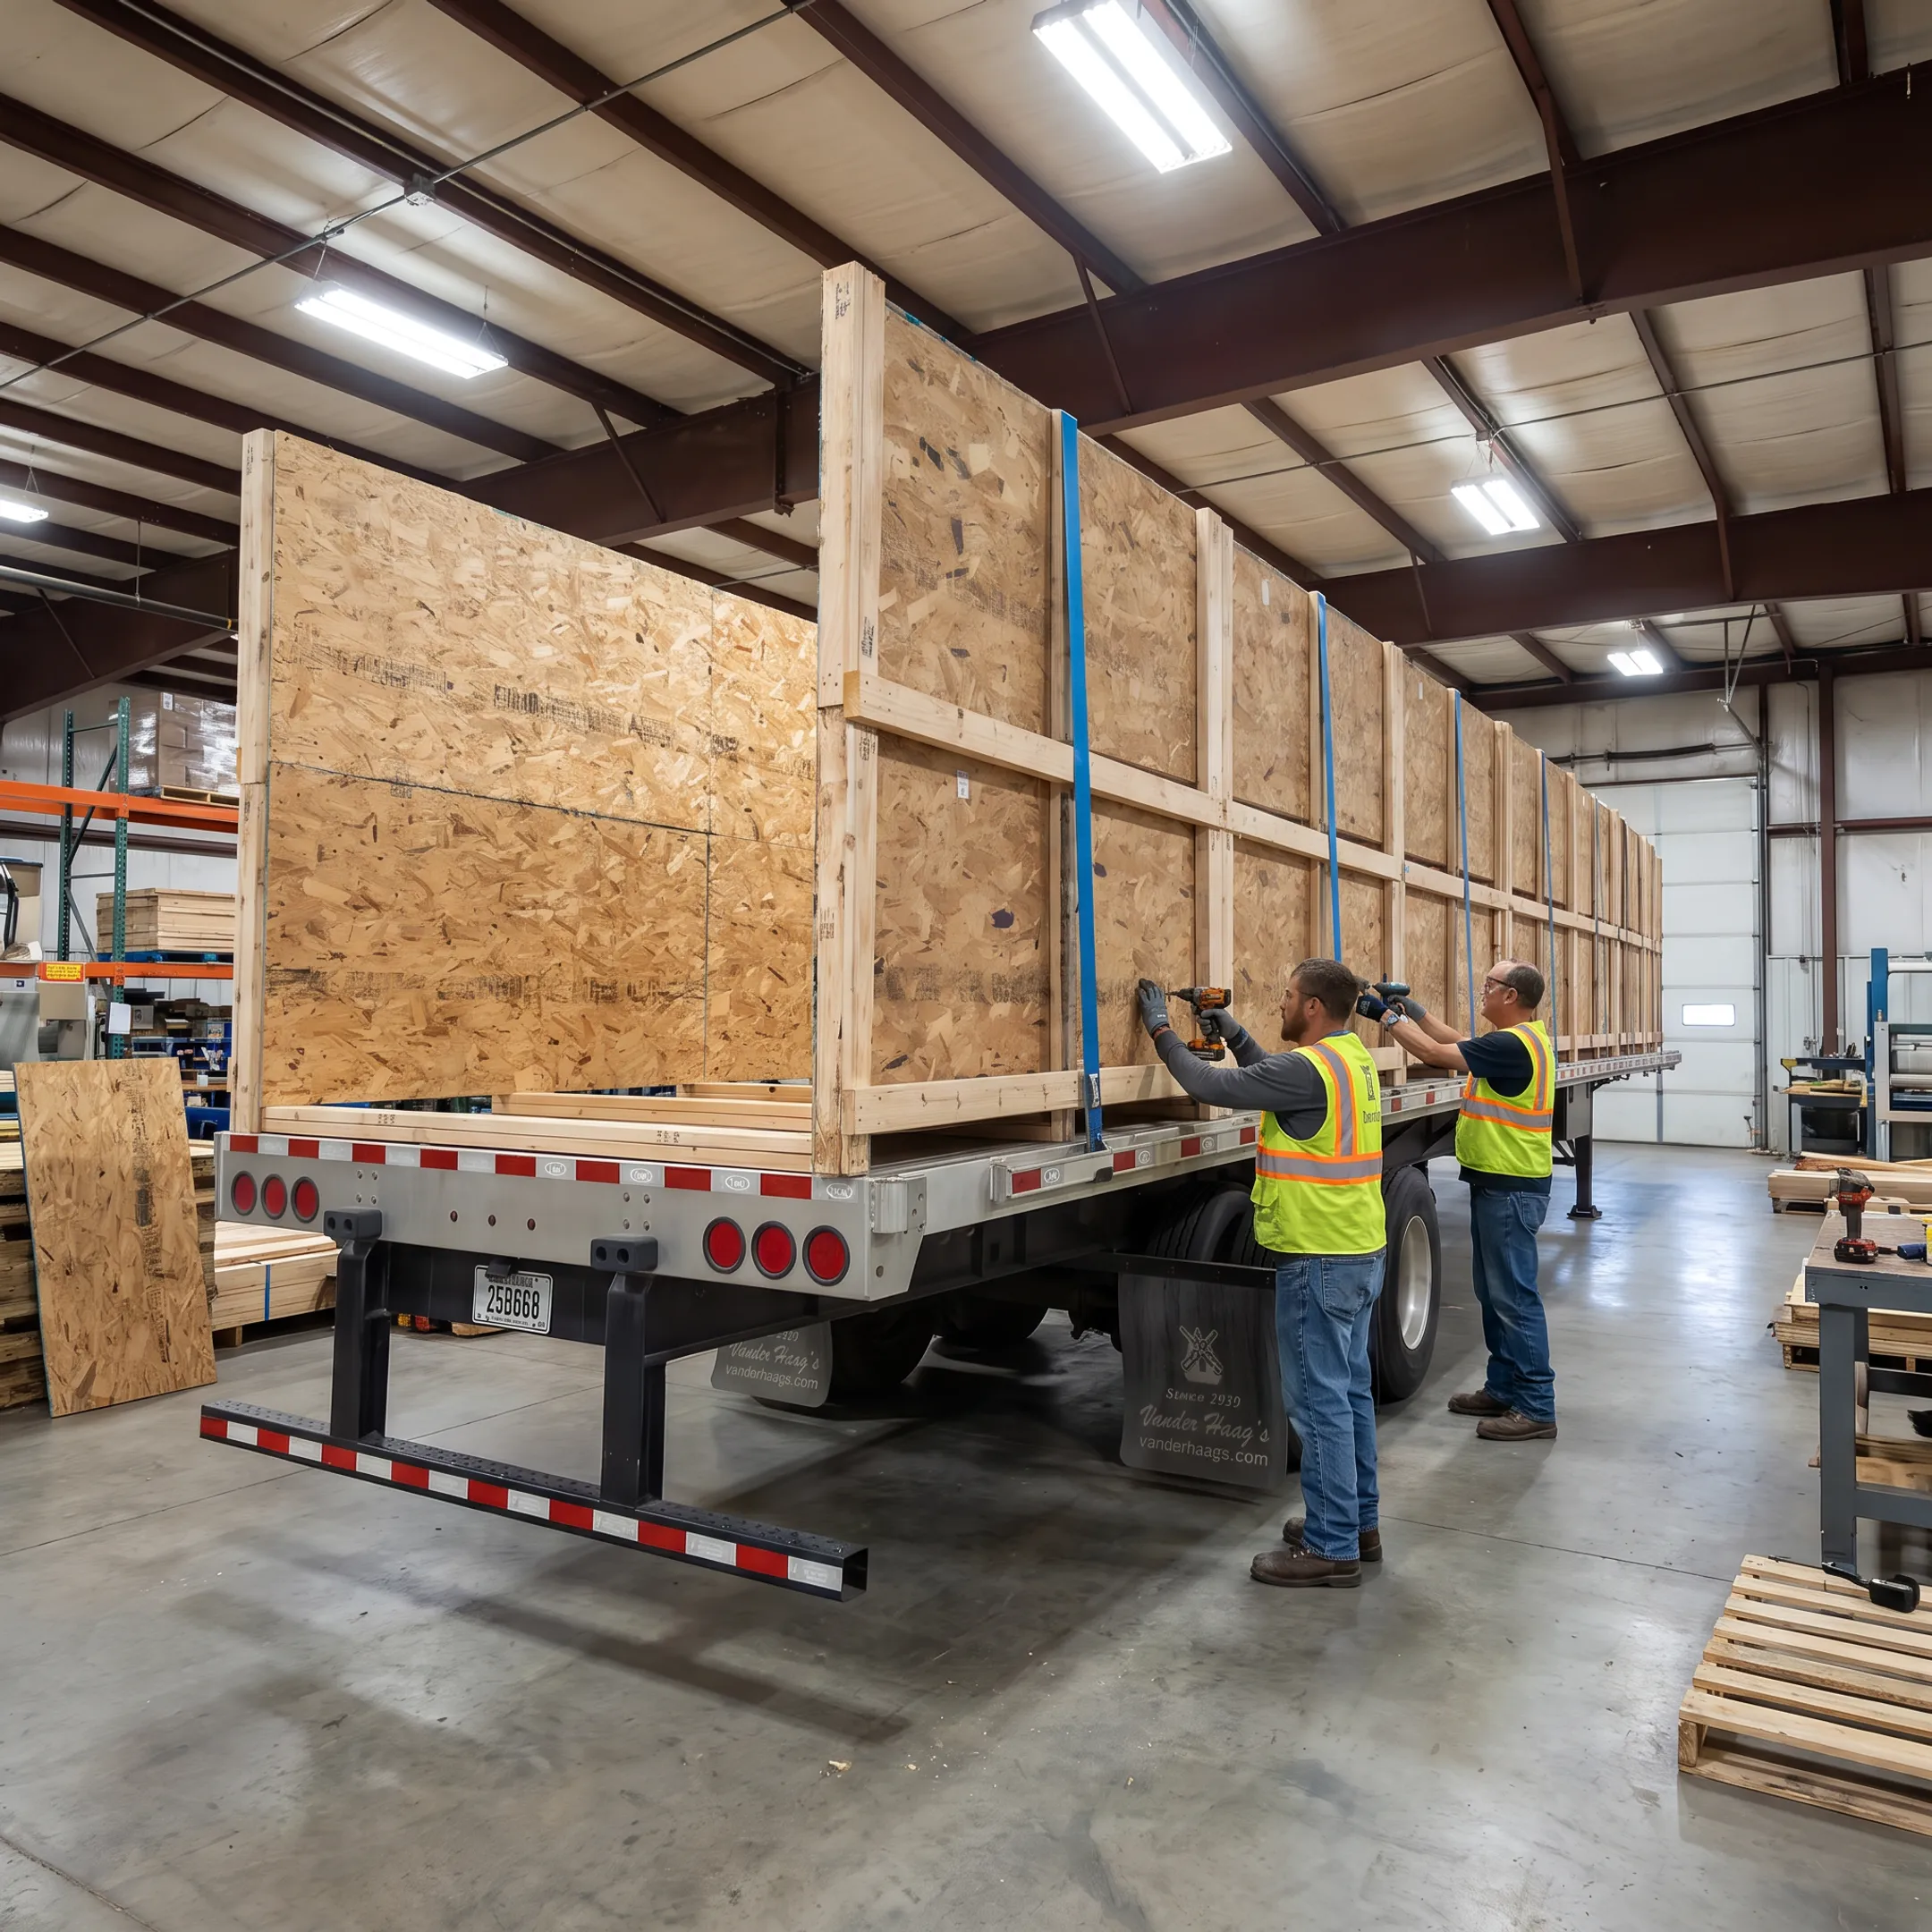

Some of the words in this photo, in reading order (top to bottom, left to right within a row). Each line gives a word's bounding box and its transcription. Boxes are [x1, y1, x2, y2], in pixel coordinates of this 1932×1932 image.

[487, 1284, 540, 1319] 25B668
[725, 1364, 818, 1389] vanderhaags.com
[1140, 1403, 1198, 1431] Vander
[1204, 1412, 1270, 1447] Haag's
[1140, 1436, 1268, 1466] vanderhaags.com
